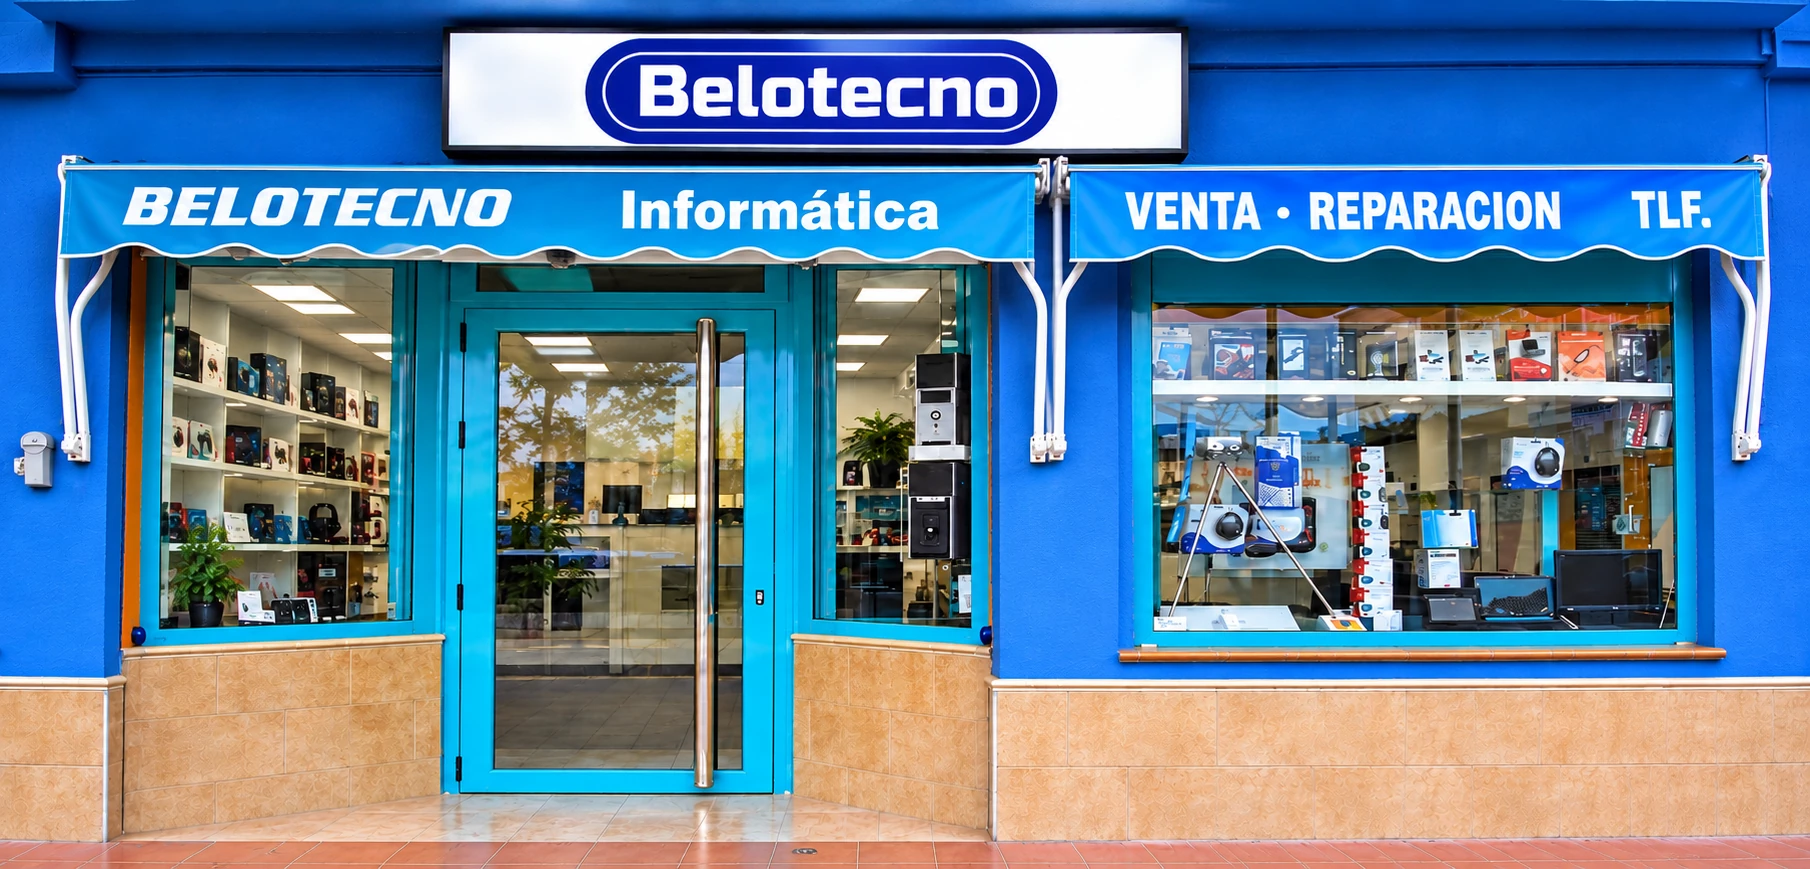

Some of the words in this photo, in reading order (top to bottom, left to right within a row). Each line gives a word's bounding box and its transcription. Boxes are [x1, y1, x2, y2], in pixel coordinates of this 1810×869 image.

[639, 65, 1019, 118] Belotecno
[123, 187, 512, 227] BELOTECNO
[622, 190, 939, 231] Informática
[1125, 192, 1261, 230] VENTA
[1310, 190, 1561, 231] REPARACION
[1632, 191, 1712, 229] TLF.
